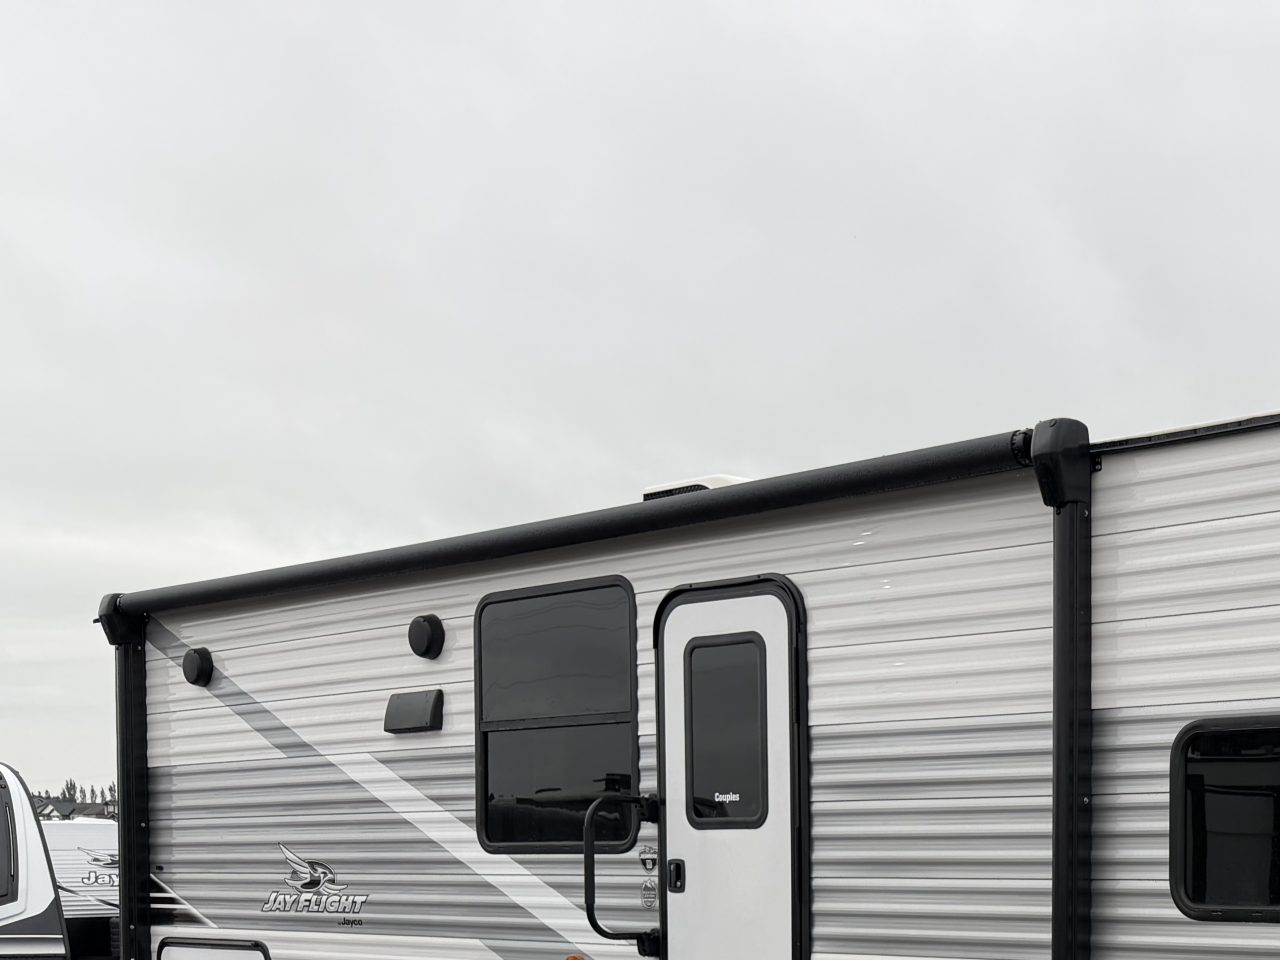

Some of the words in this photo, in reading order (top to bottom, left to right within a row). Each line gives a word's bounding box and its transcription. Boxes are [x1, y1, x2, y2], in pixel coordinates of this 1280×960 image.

[714, 792, 740, 804] Couples
[81, 870, 120, 887] Jay
[261, 891, 299, 913] JAY
[296, 892, 369, 914] FLIGHT
[341, 917, 363, 928] Jayco
